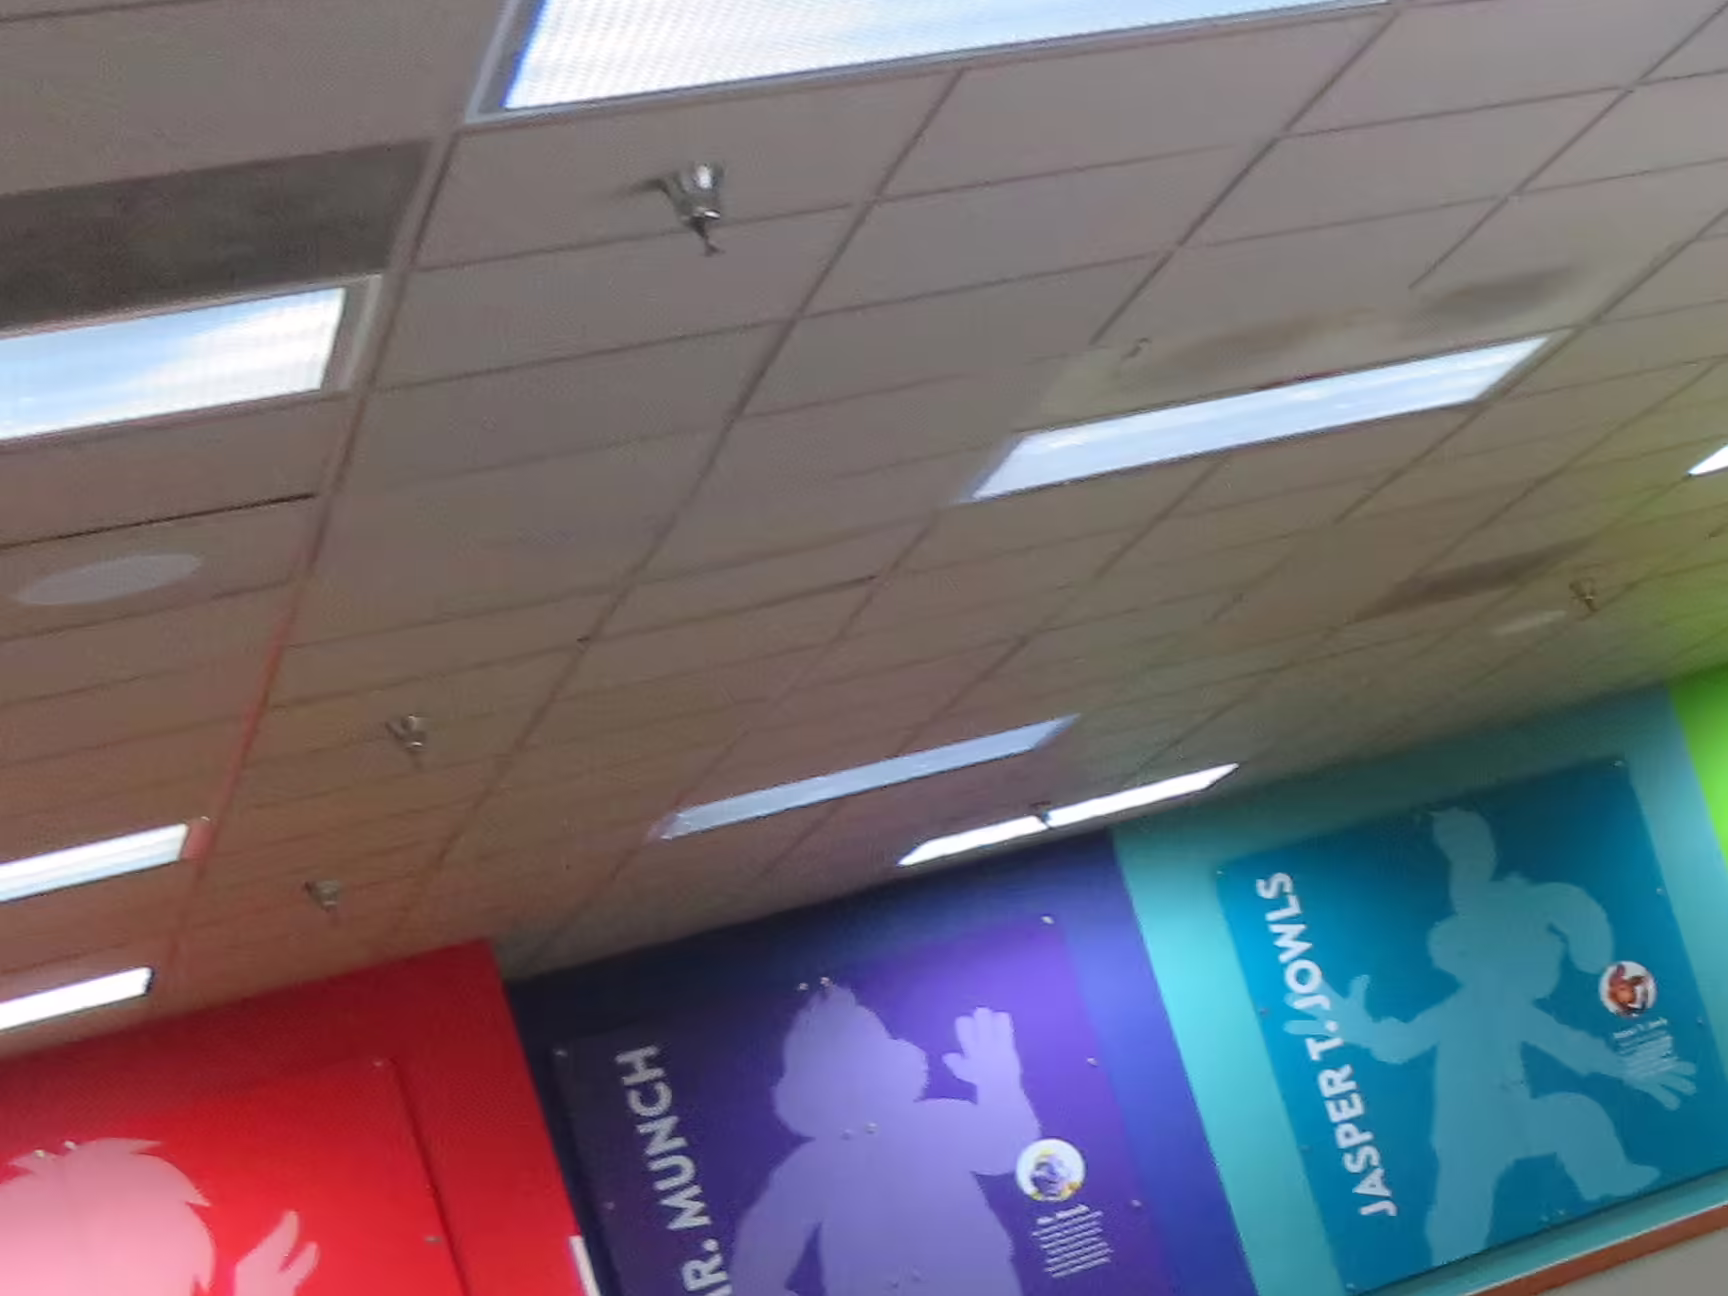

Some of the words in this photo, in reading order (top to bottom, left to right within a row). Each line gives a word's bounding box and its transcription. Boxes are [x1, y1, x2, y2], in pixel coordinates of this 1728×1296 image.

[1255, 871, 1332, 1011] JOWLS
[1304, 1019, 1345, 1061] T.
[614, 1044, 713, 1231] MUNCH
[1317, 1063, 1399, 1218] JASPER
